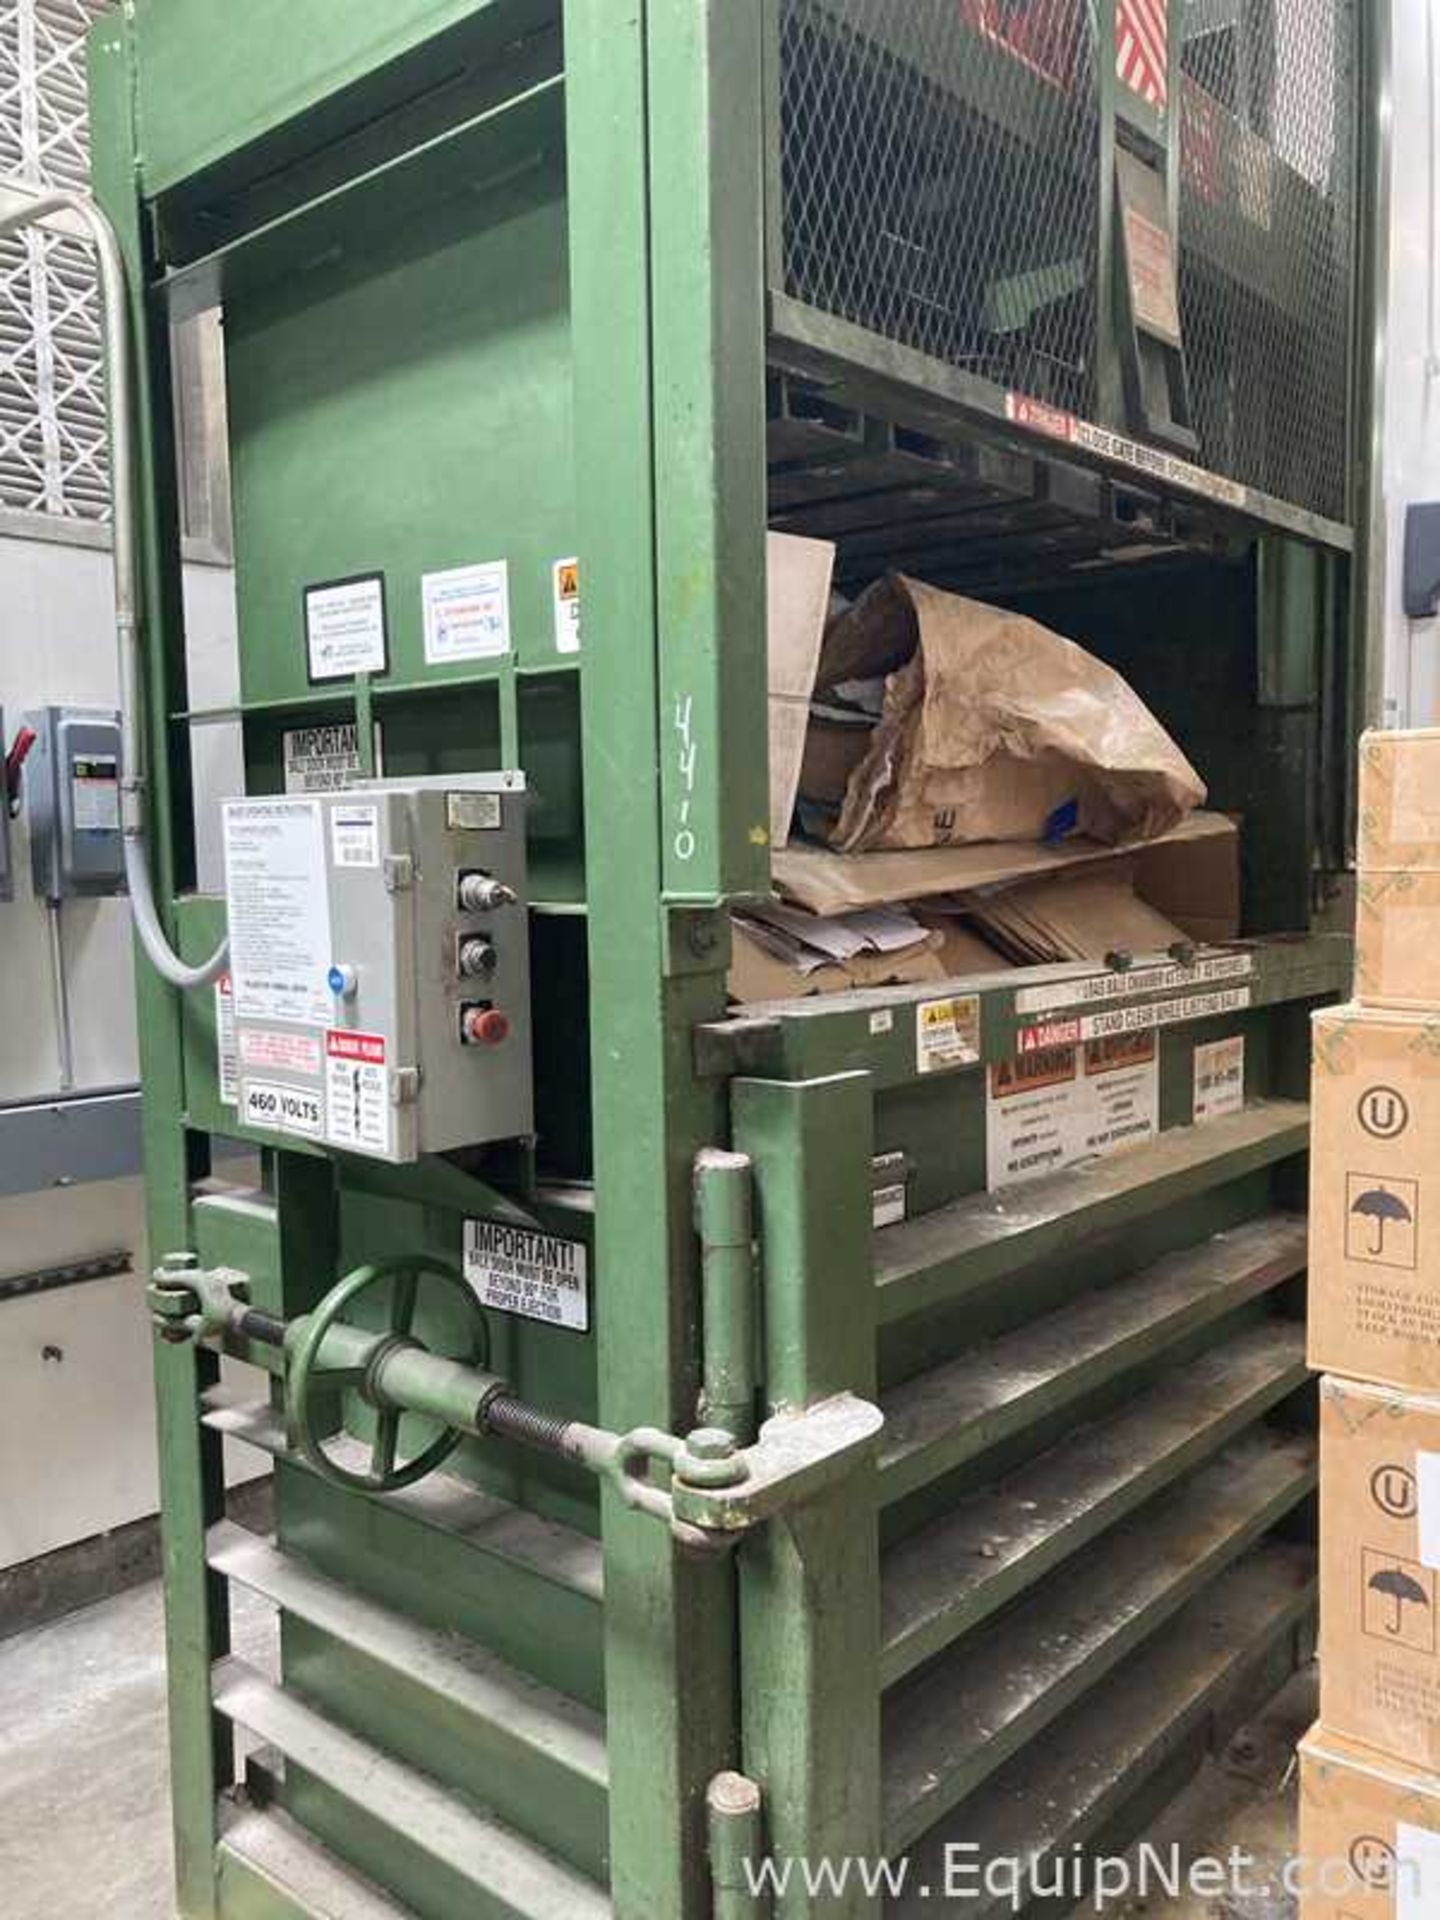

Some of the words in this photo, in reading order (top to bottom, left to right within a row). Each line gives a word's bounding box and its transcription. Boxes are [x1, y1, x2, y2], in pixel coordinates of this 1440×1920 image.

[292, 725, 357, 756] IMPORTAN
[1038, 1020, 1078, 1046] DANGER
[1093, 1014, 1123, 1036] STAND
[1126, 1008, 1153, 1028] CLEAR
[249, 1092, 276, 1113] 460
[281, 1095, 318, 1121] VOLTS
[475, 1222, 574, 1271] IMPORTANT!
[492, 1256, 514, 1274] DOOR
[516, 1261, 540, 1281] MUST
[556, 1272, 579, 1291] OPEN
[486, 1288, 518, 1308] PROPER
